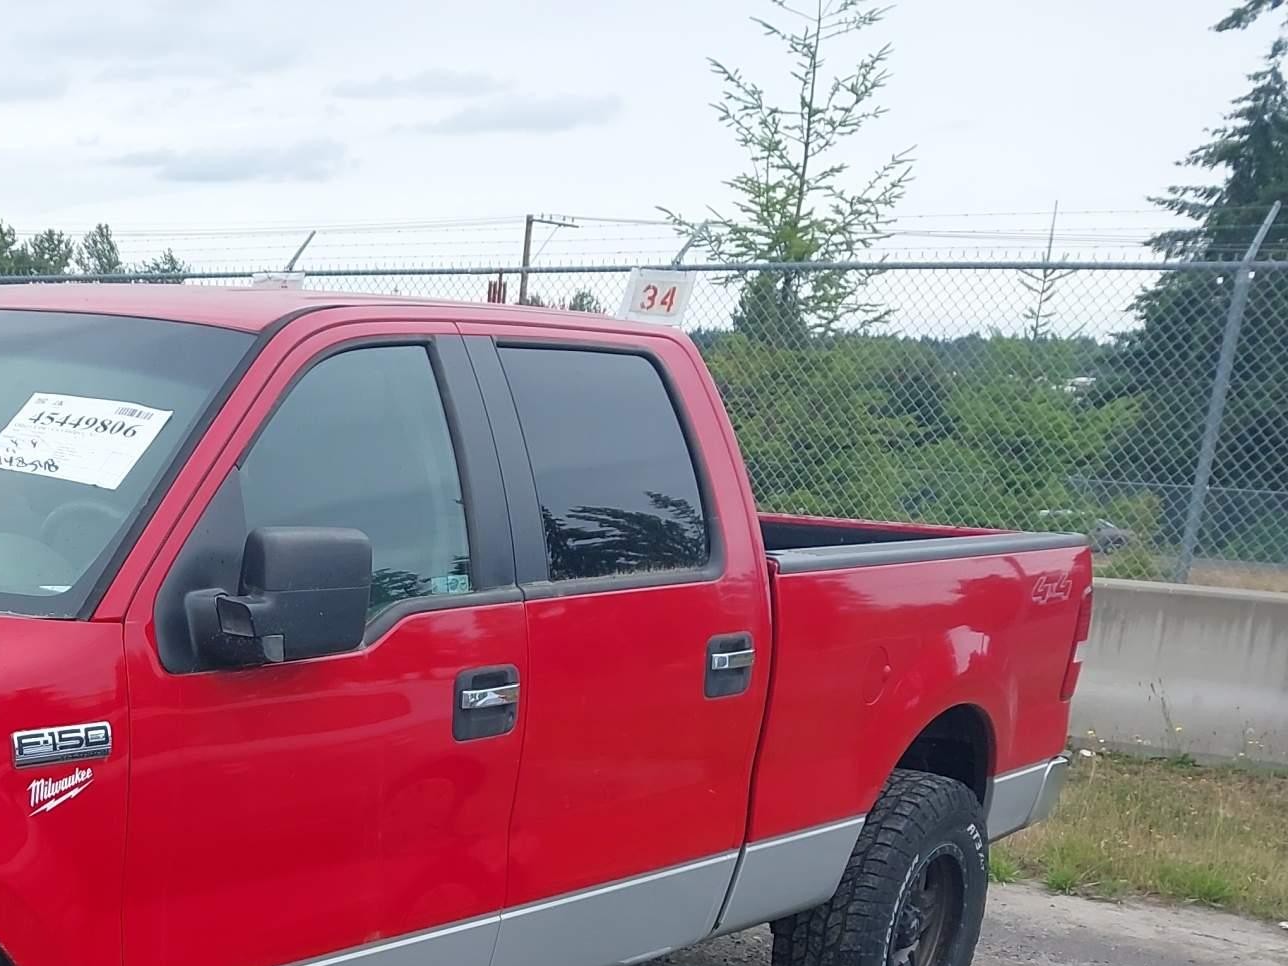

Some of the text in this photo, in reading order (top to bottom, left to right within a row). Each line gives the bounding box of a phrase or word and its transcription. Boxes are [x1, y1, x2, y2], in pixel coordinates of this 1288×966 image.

[640, 284, 677, 312] 34
[28, 411, 145, 438] 45449806
[16, 725, 110, 756] F-150
[27, 767, 93, 807] Milwaukee
